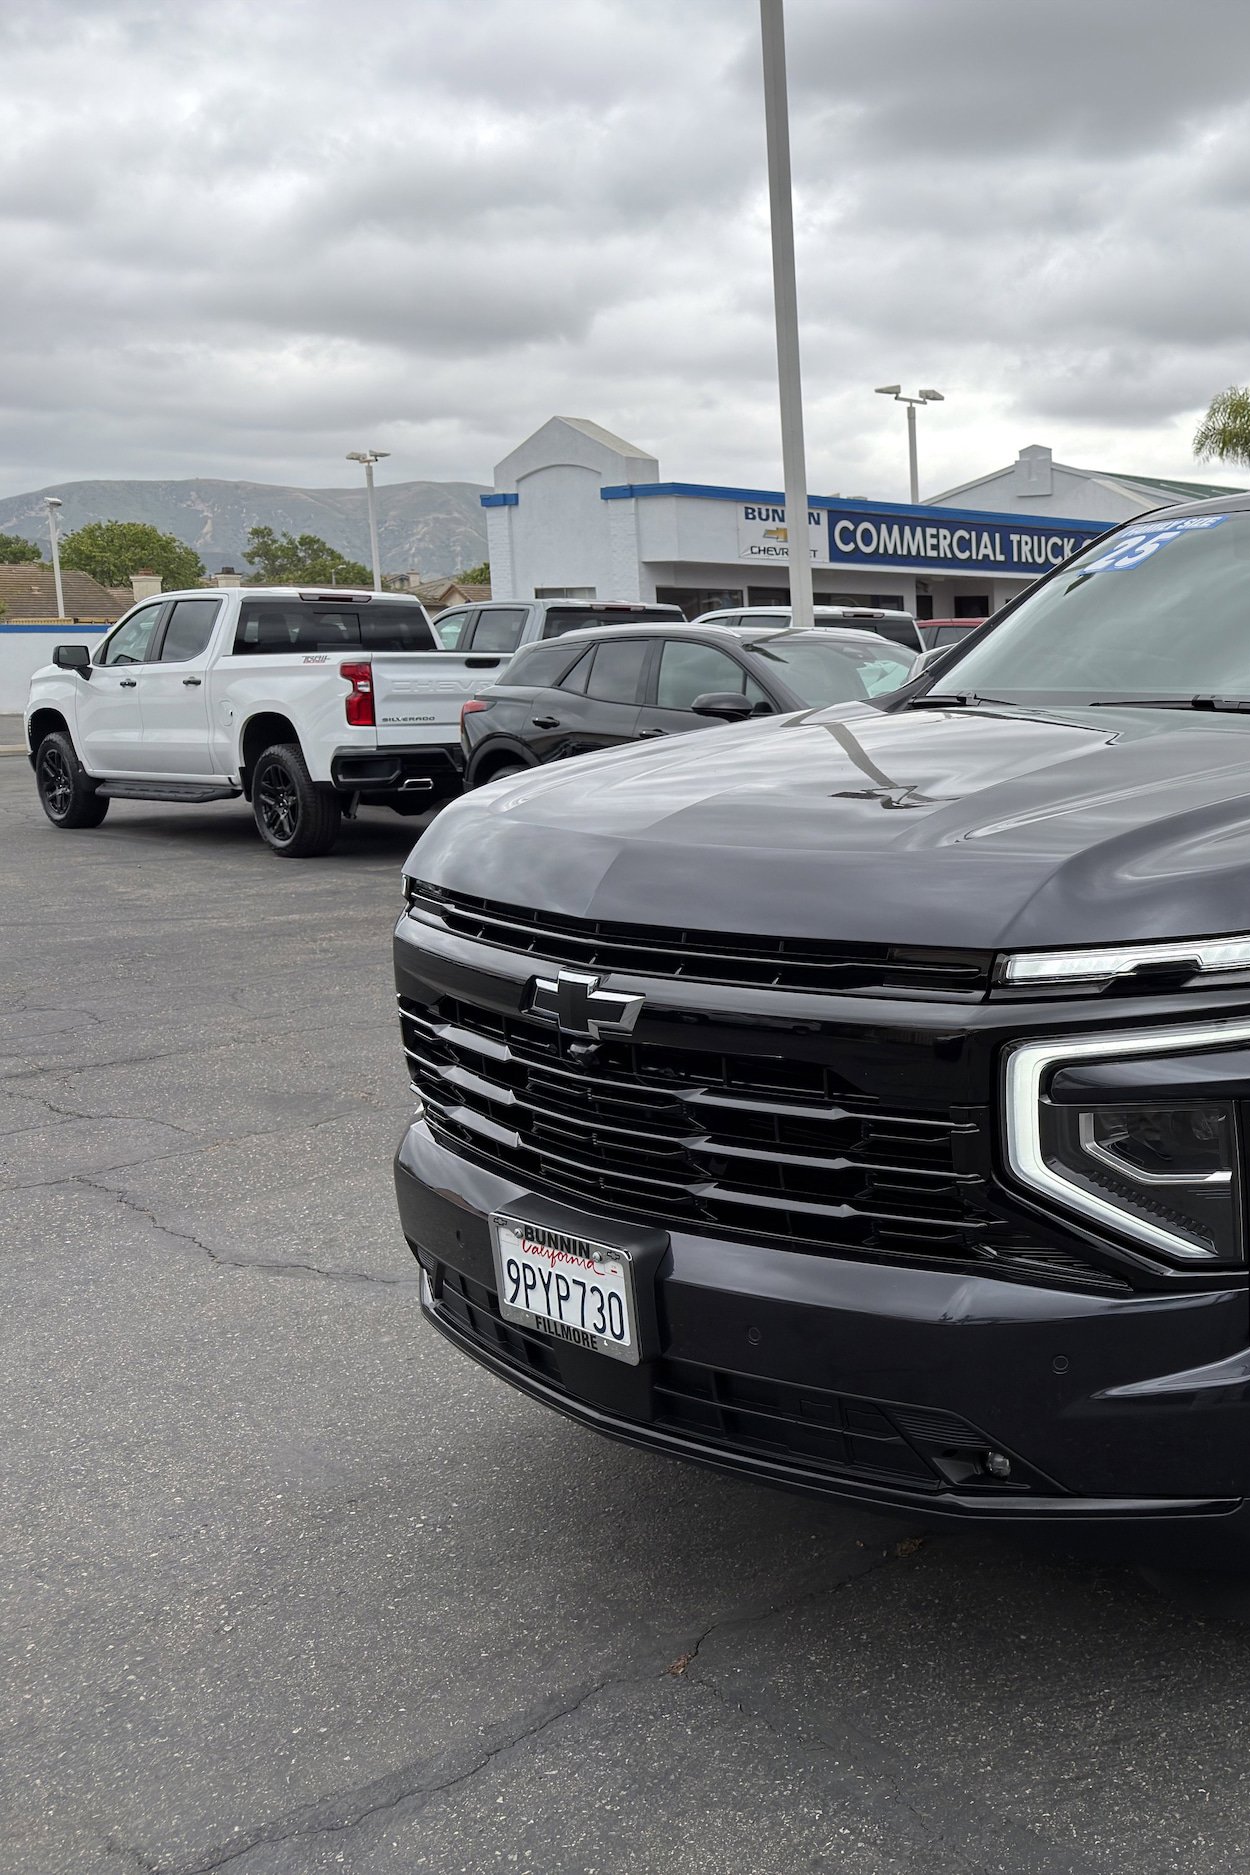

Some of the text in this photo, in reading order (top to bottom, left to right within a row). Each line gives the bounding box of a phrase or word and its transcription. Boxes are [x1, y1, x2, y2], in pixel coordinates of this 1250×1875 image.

[744, 506, 821, 525] BUNN
[1177, 516, 1223, 530] SIZE
[750, 546, 819, 558] CHEVRT
[834, 519, 1076, 564] COMMERCIAL TRUCK
[1083, 531, 1181, 572] 25
[522, 1239, 605, 1276] California
[523, 1224, 590, 1259] BUNNIN
[506, 1257, 625, 1341] 9PYP730
[535, 1315, 599, 1351] FILLMORE
